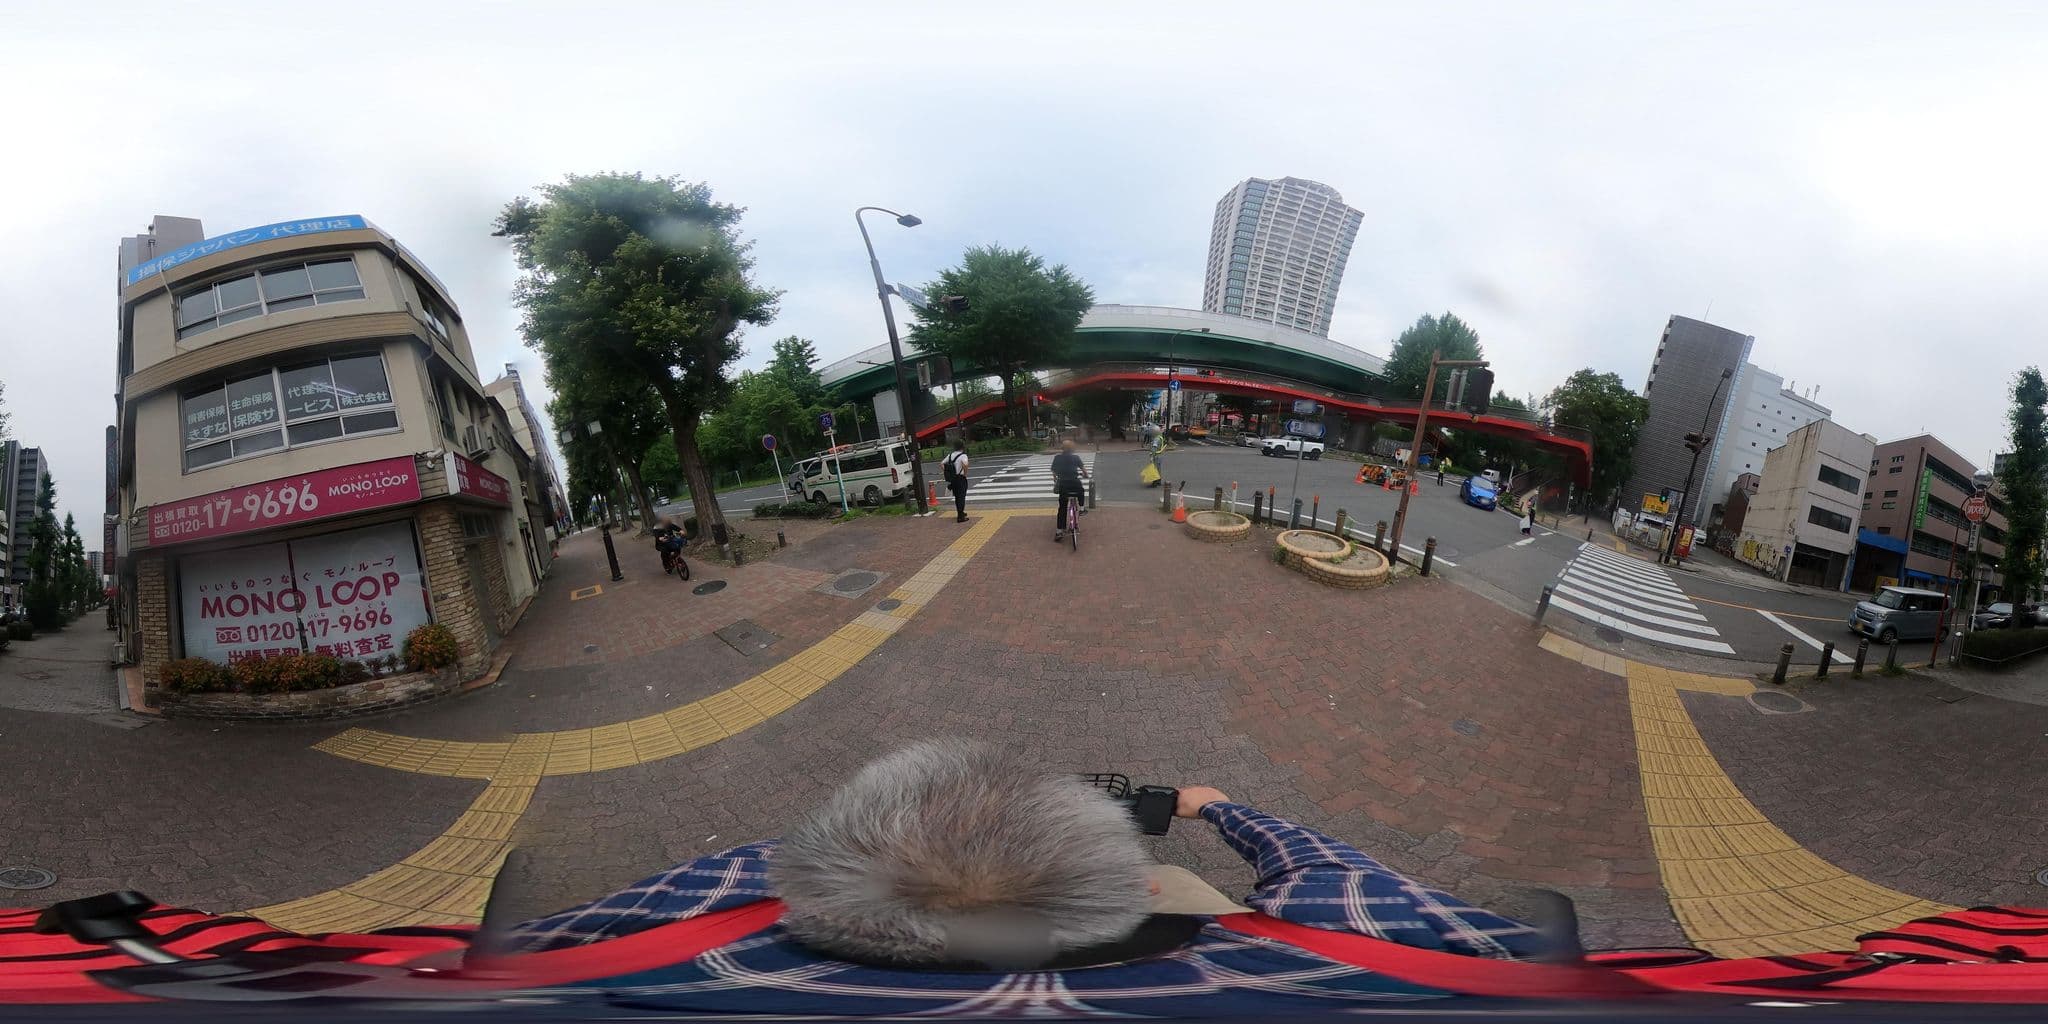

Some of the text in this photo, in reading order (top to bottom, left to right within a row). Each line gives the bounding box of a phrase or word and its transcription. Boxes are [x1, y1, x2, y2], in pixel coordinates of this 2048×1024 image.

[271, 219, 351, 236] 代理店
[231, 391, 273, 411] 生命保険
[328, 474, 409, 497] MONO LOOP
[154, 504, 200, 524] 出張買取
[199, 558, 395, 592] いいものつなぐ モノ・ループ
[201, 571, 400, 618] MONO LOOP
[315, 635, 394, 659] 無料査定
